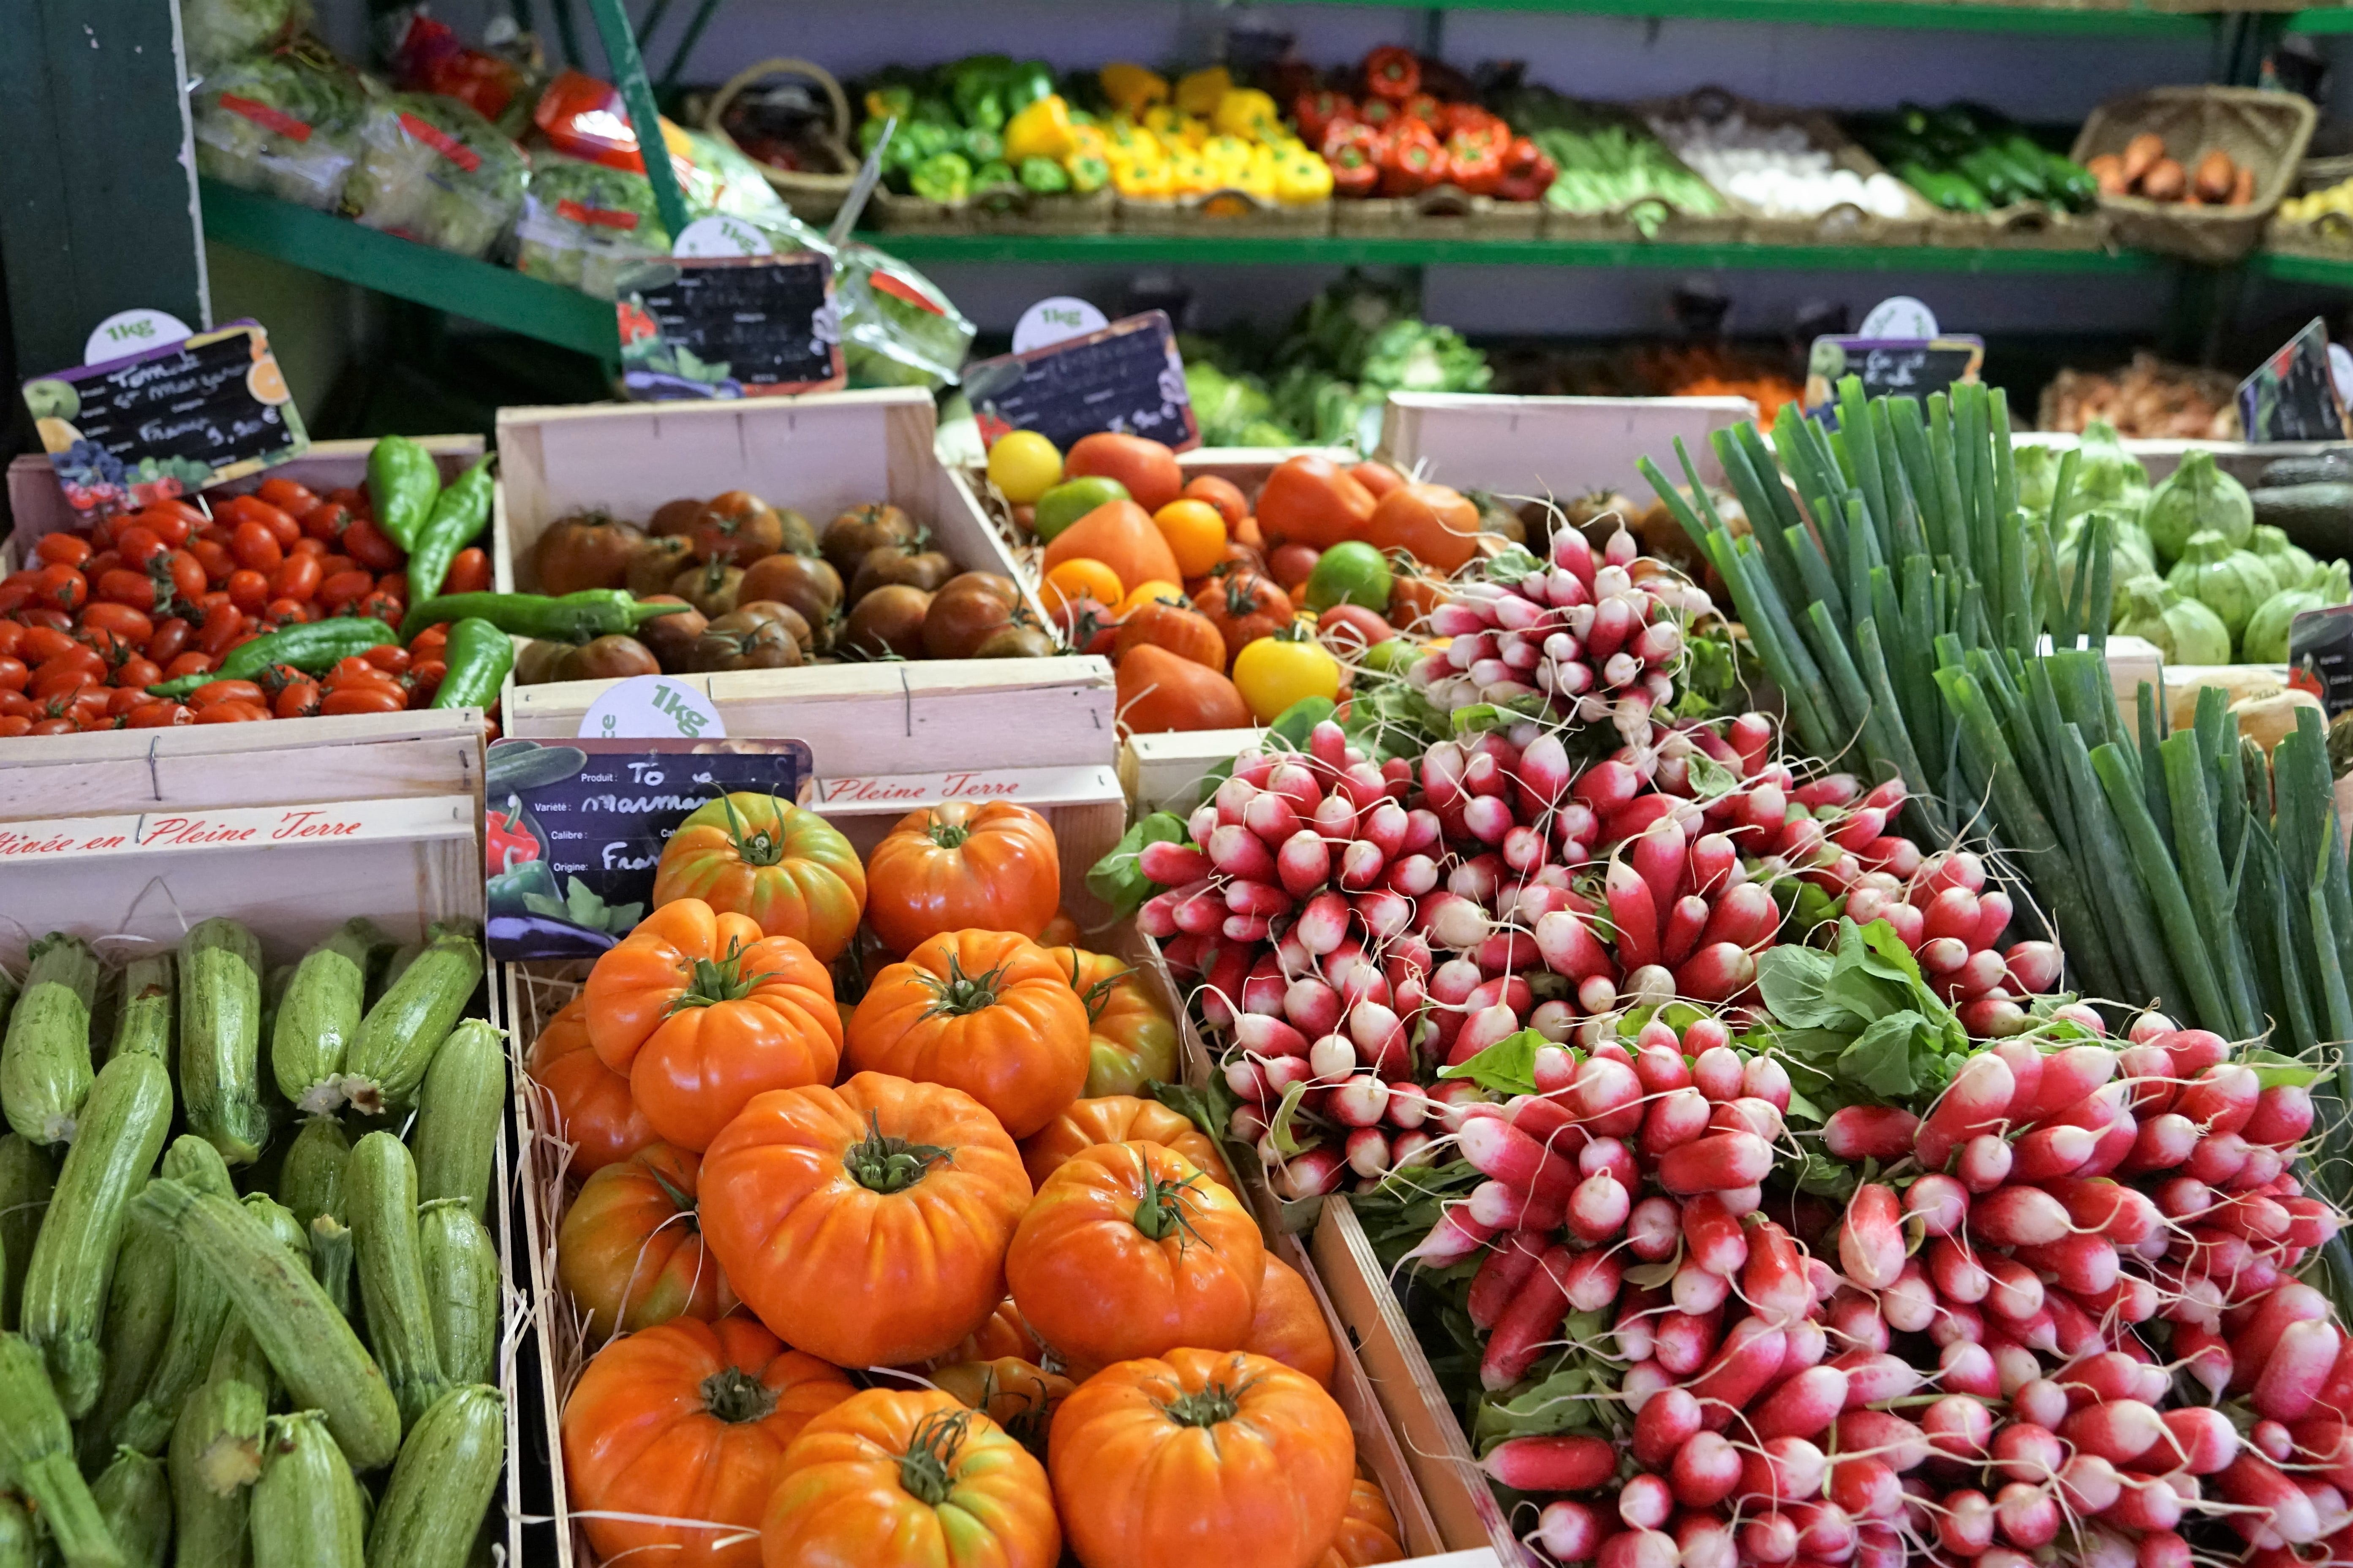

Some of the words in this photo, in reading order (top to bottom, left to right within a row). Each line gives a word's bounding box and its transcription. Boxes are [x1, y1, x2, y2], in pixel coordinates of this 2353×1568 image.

[107, 319, 156, 341] 1kg
[652, 685, 709, 738] 1kg
[827, 779, 925, 801] Pleine
[941, 772, 1019, 797] Terre
[76, 837, 125, 850] en
[141, 818, 256, 845] Pleine
[272, 811, 361, 839] Terre
